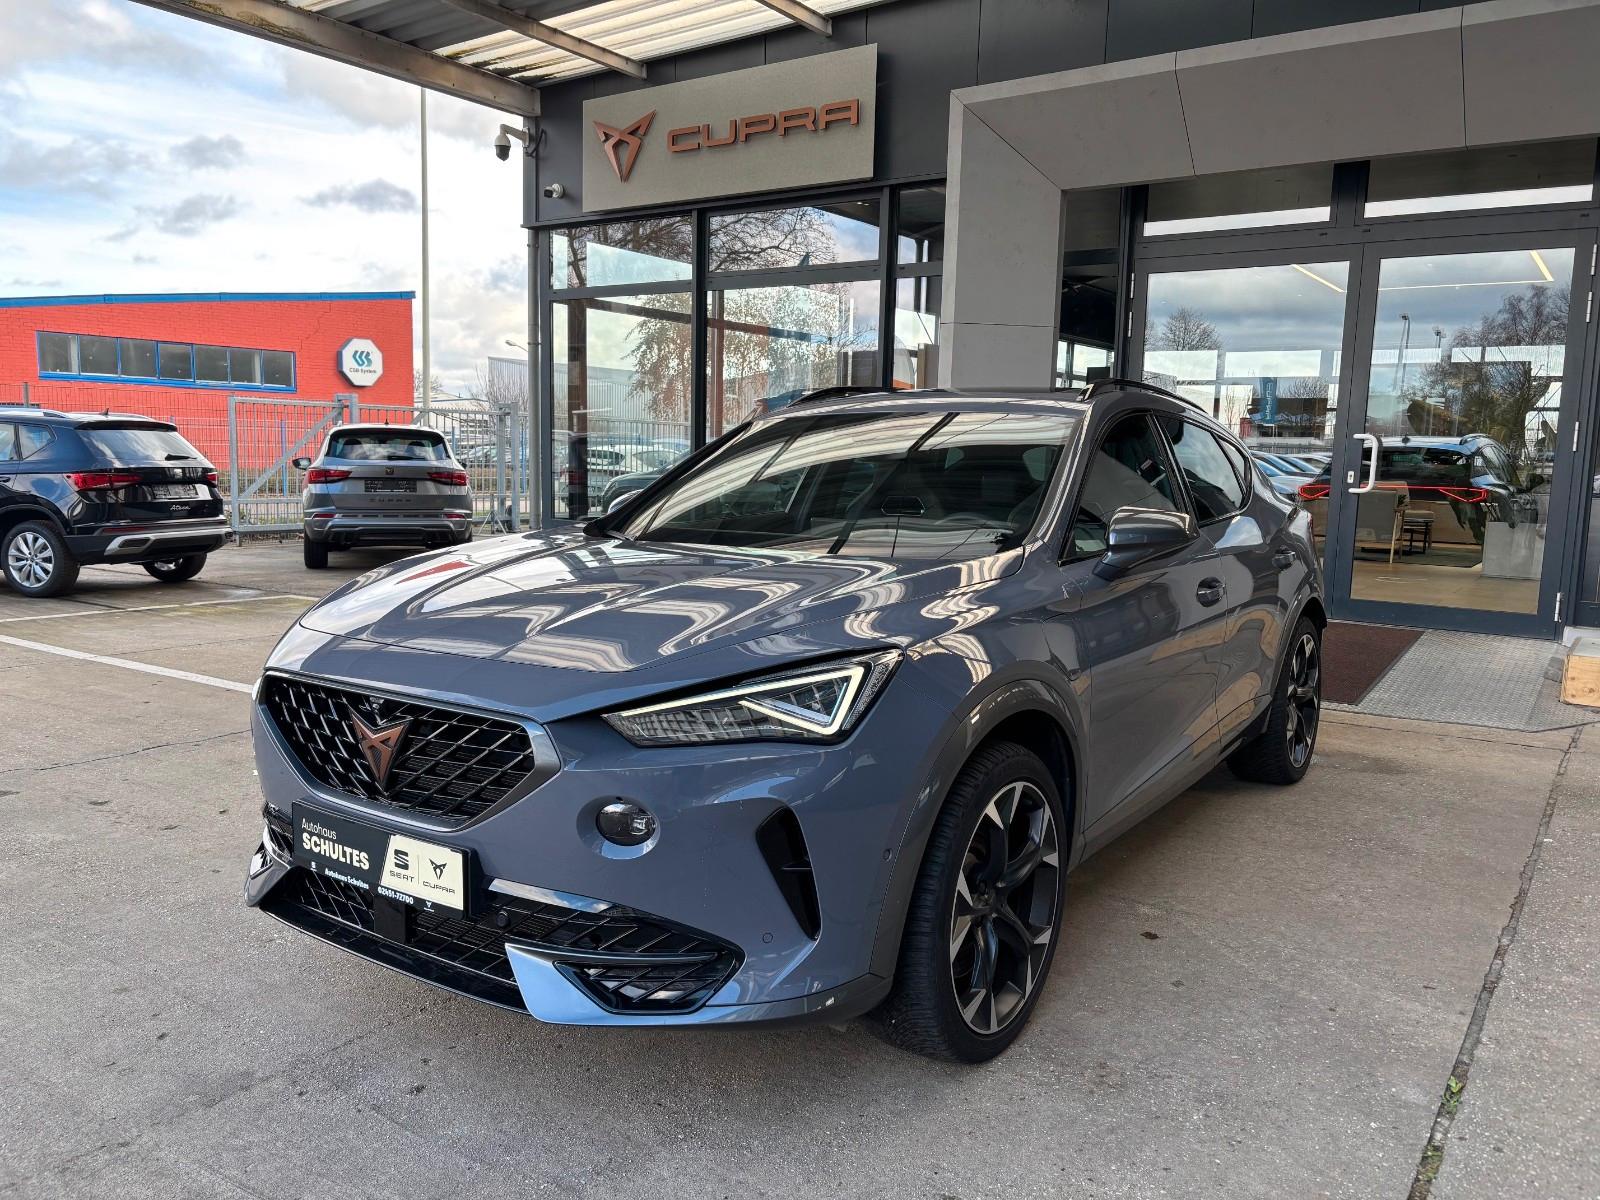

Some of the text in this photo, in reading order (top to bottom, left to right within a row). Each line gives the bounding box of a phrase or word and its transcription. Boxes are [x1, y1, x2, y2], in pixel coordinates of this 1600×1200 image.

[667, 99, 859, 152] CUPRA
[302, 818, 336, 840] Autohaus
[302, 833, 370, 870] SCHULTES
[390, 870, 414, 883] SEAT
[422, 881, 456, 895] CUPRA
